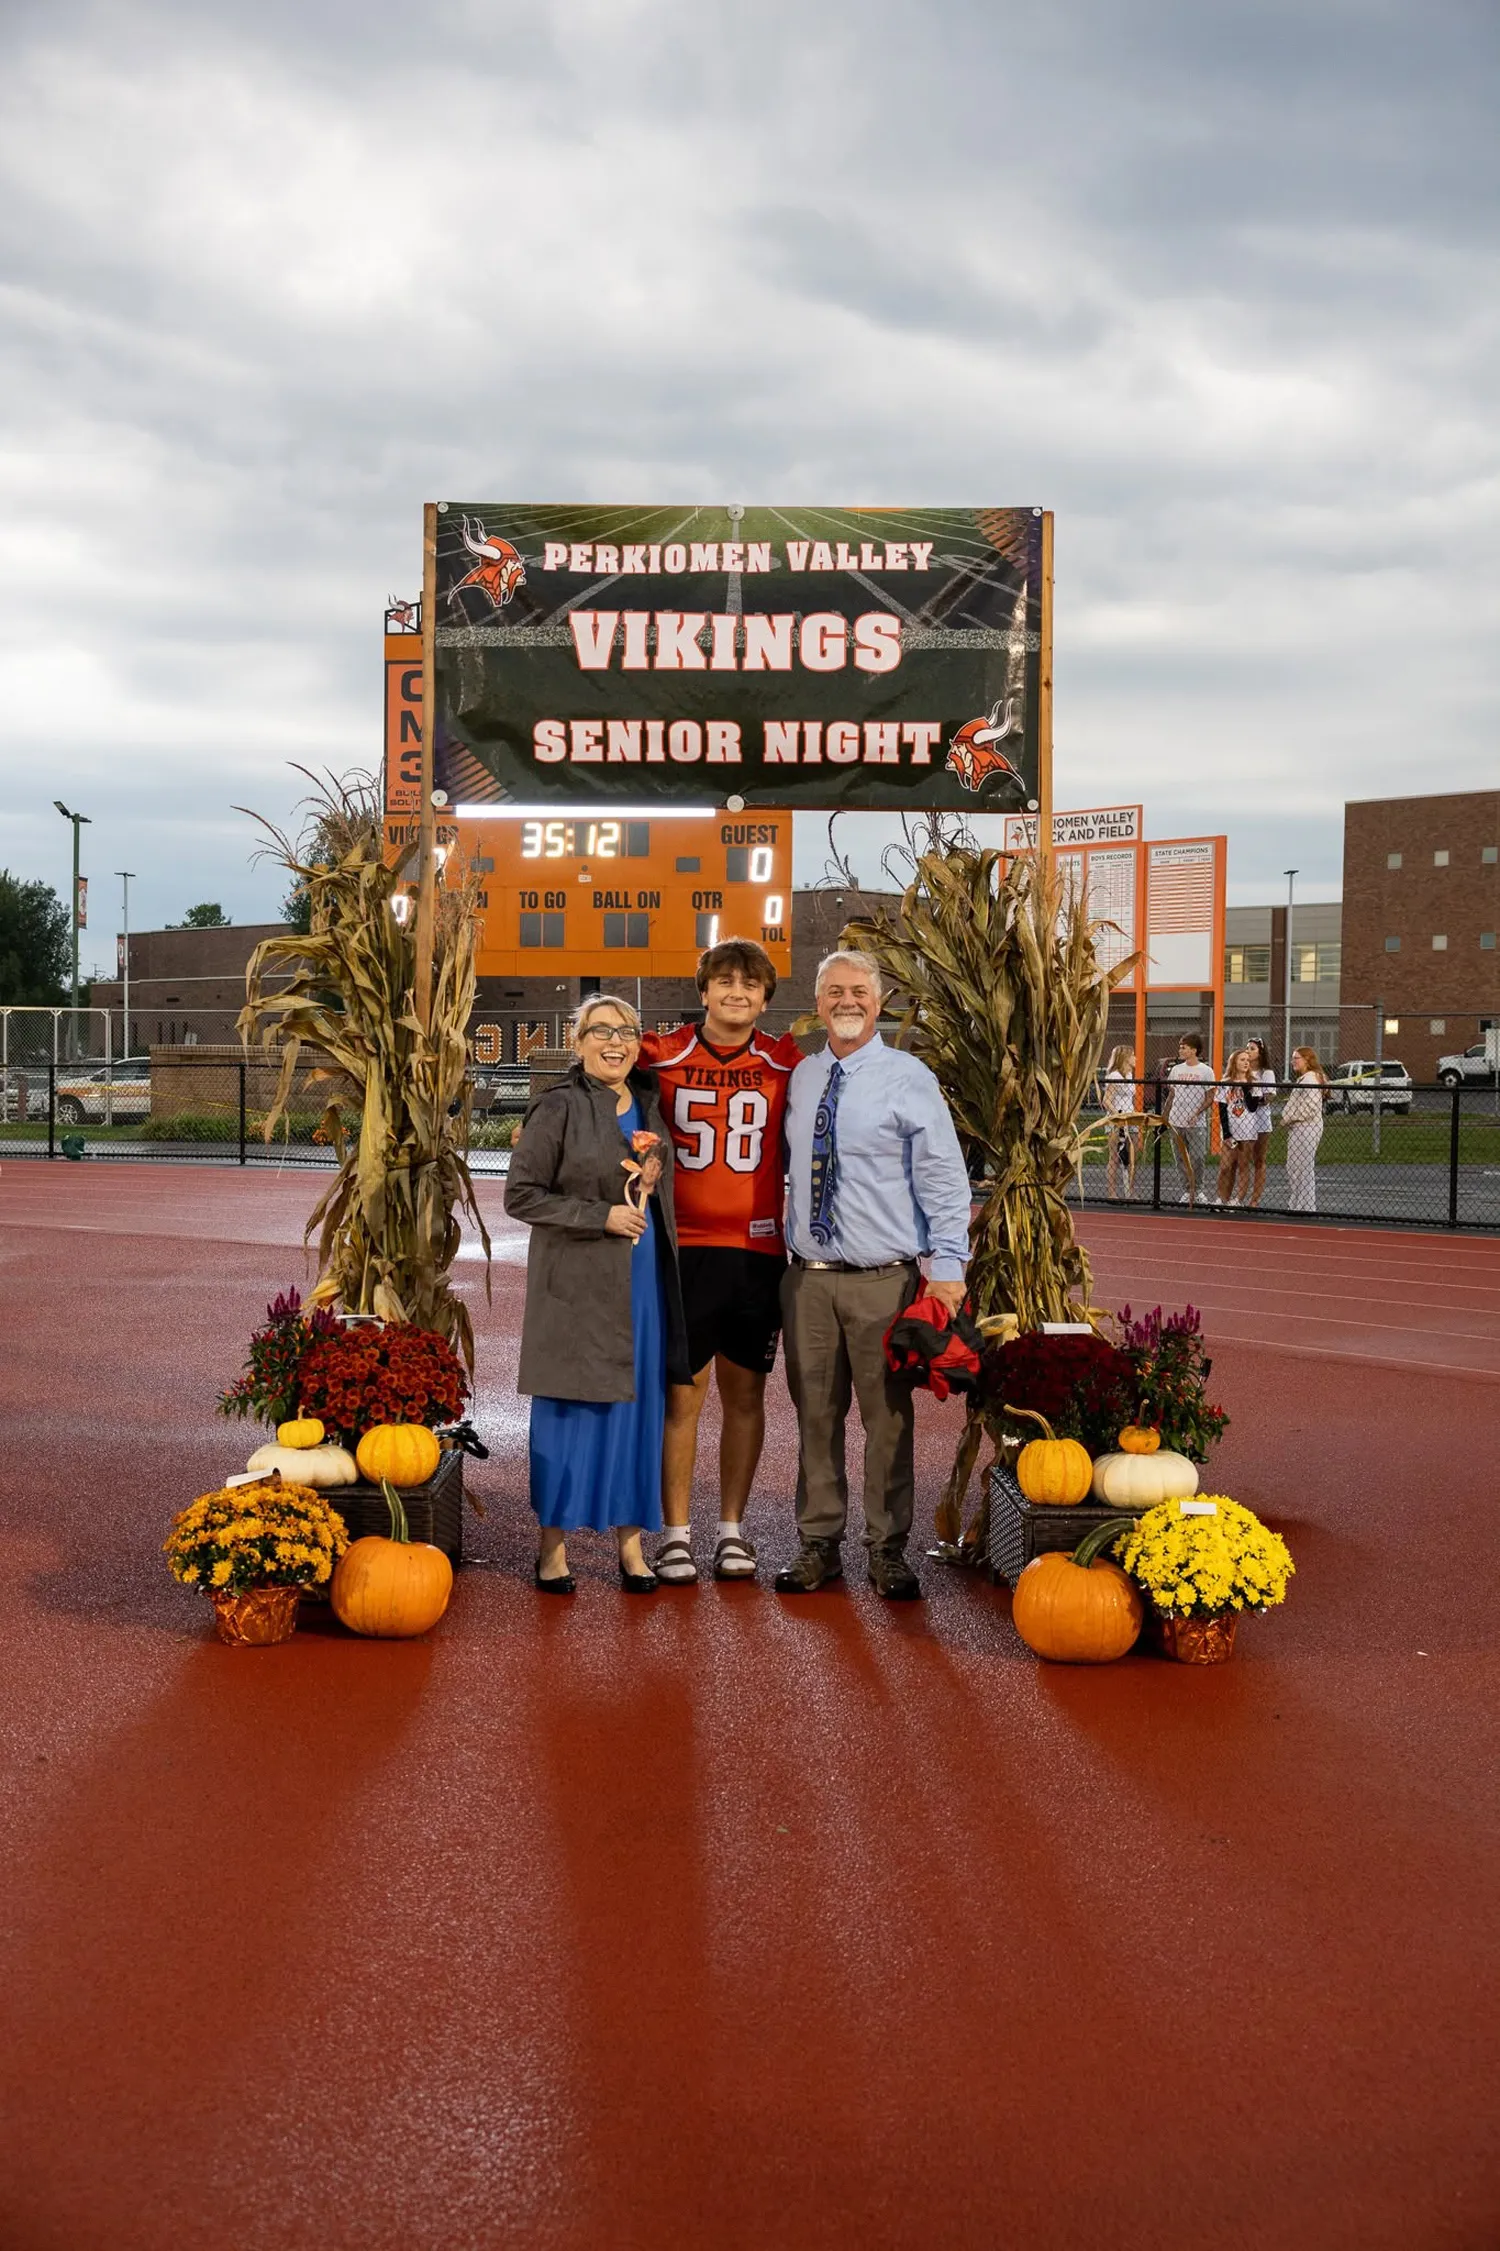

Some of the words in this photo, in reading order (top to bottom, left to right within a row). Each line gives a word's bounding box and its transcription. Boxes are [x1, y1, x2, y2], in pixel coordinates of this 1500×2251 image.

[542, 541, 772, 574] PERKIOMEN
[785, 540, 934, 572] VALLEY
[568, 610, 904, 673] VIKINGS
[532, 718, 743, 764] SENIOR
[763, 720, 942, 766] NIGHT
[1092, 811, 1134, 826] VALLEY
[721, 824, 779, 845] GUEST
[1068, 828, 1095, 841] AND
[1099, 825, 1134, 838] FIELD
[750, 847, 773, 882] 0
[519, 891, 539, 909] TO
[544, 891, 566, 909] GO
[593, 891, 632, 909] BALL
[637, 891, 661, 909] ON
[692, 891, 722, 911] QTR
[764, 895, 783, 925] 0
[761, 927, 787, 942] TOL
[683, 1065, 763, 1087] VIKINGS
[674, 1087, 769, 1173] 58
